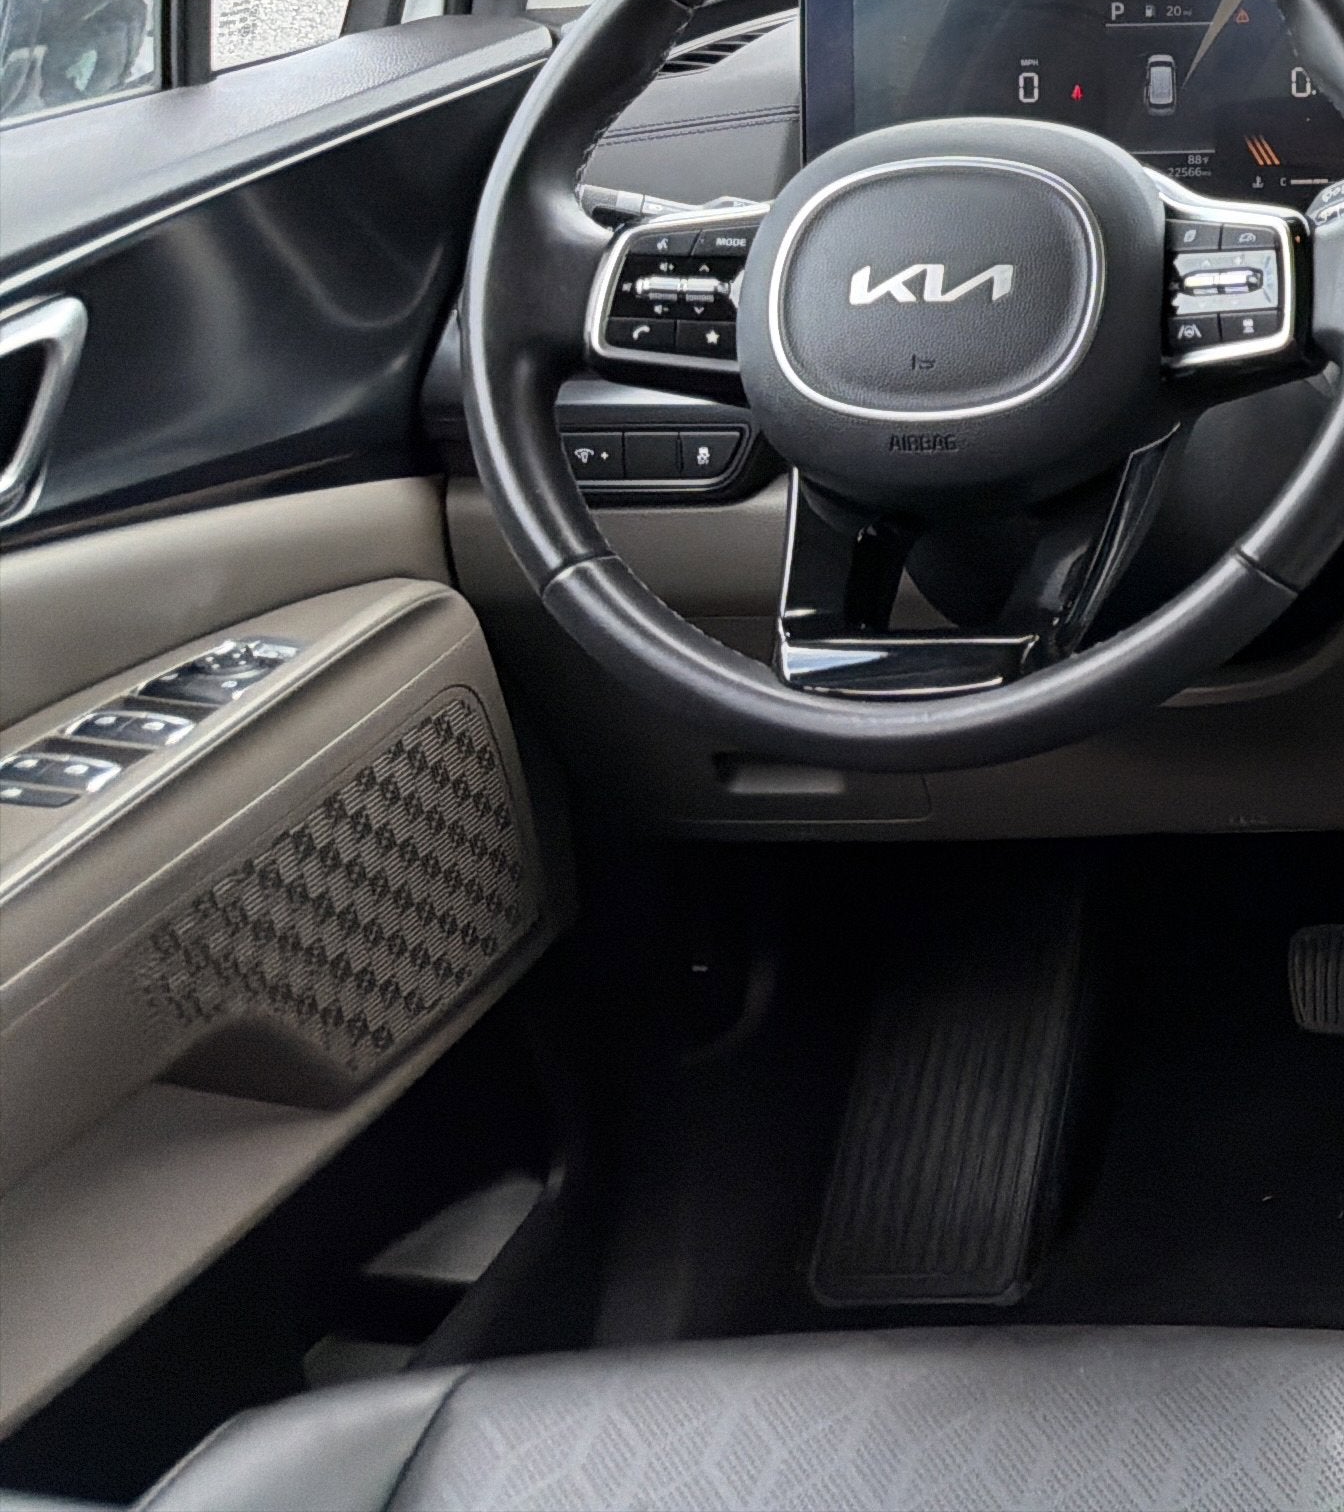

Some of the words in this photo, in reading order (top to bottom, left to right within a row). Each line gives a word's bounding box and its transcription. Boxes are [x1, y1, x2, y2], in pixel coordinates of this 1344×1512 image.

[1111, 2, 1125, 20] P
[1020, 59, 1039, 67] MPH
[1018, 72, 1039, 103] 0
[715, 237, 747, 247] MODE
[849, 263, 1014, 306] KIA
[888, 433, 958, 453] AIRBAG
